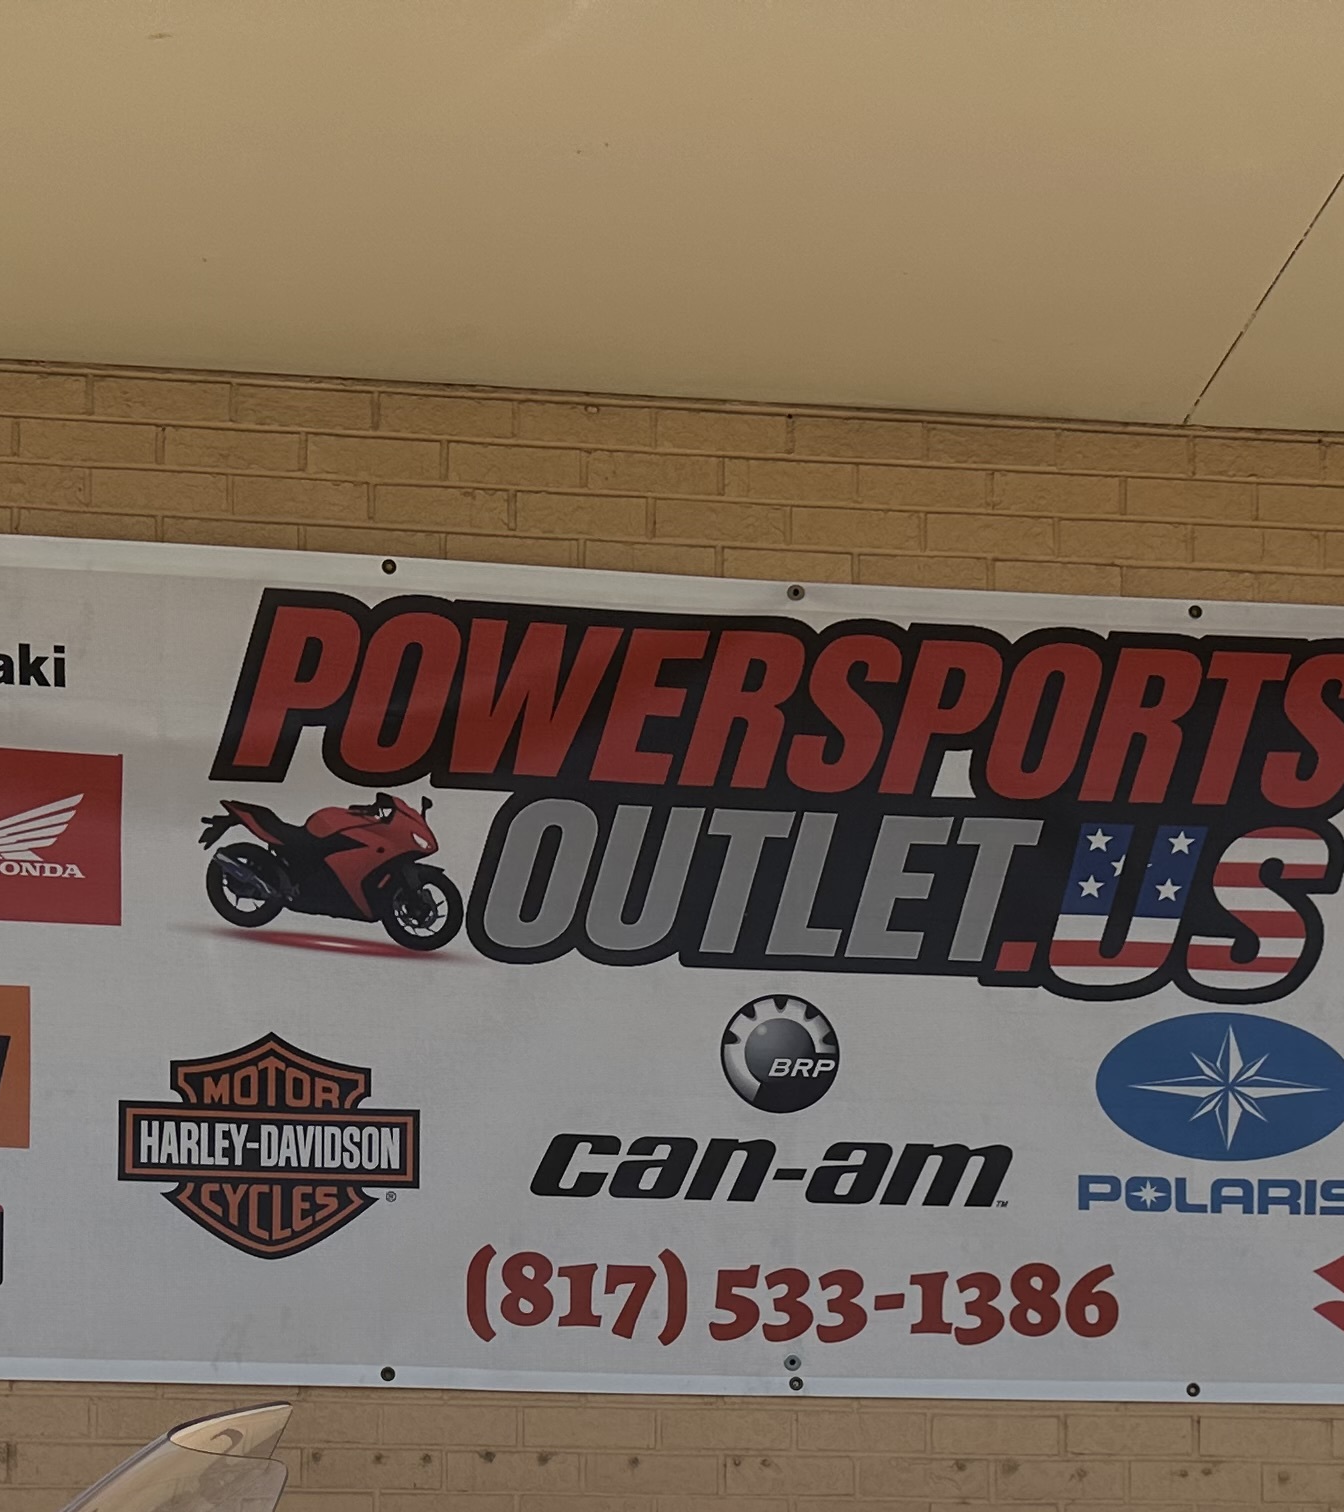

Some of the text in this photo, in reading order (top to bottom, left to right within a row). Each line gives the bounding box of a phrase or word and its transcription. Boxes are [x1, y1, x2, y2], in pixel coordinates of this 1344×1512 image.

[202, 1055, 341, 1110] MOTOR
[767, 1058, 836, 1078] BRP
[139, 1119, 401, 1171] HARLEY-DAVIDSON
[529, 1132, 1015, 1208] can-am
[200, 1182, 340, 1241] CYCLES
[466, 1243, 1121, 1347] (817) 533-1386
